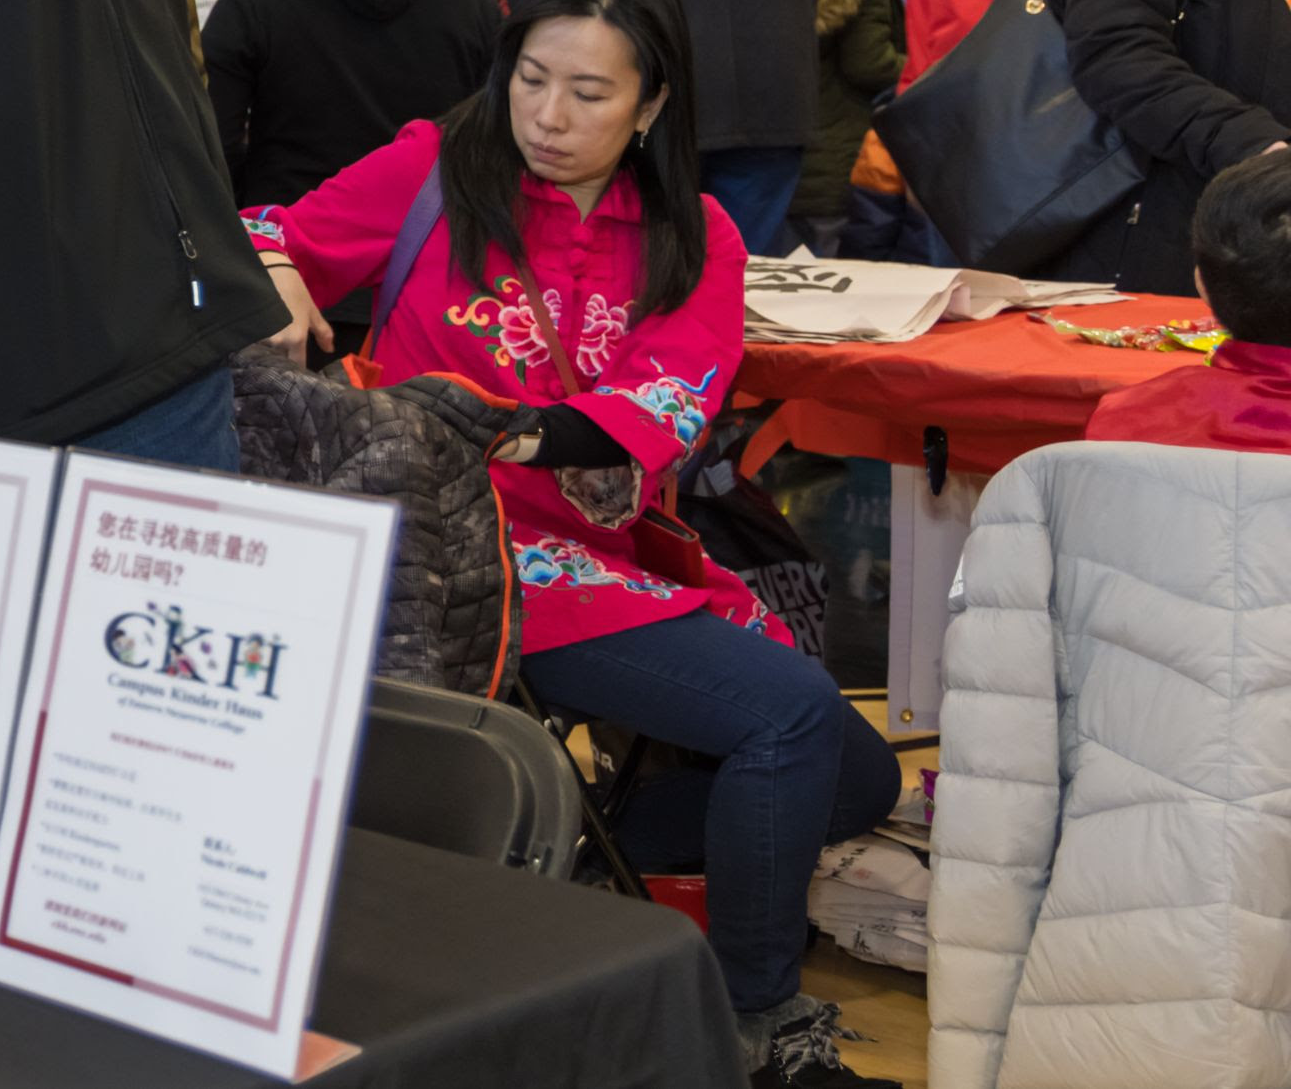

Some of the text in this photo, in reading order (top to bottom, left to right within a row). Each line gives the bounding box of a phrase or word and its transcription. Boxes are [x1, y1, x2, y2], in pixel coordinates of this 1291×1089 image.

[97, 509, 269, 567] 您在寻找高质量的
[103, 608, 290, 700] CKH
[107, 672, 265, 721] Campus Kinder Haus
